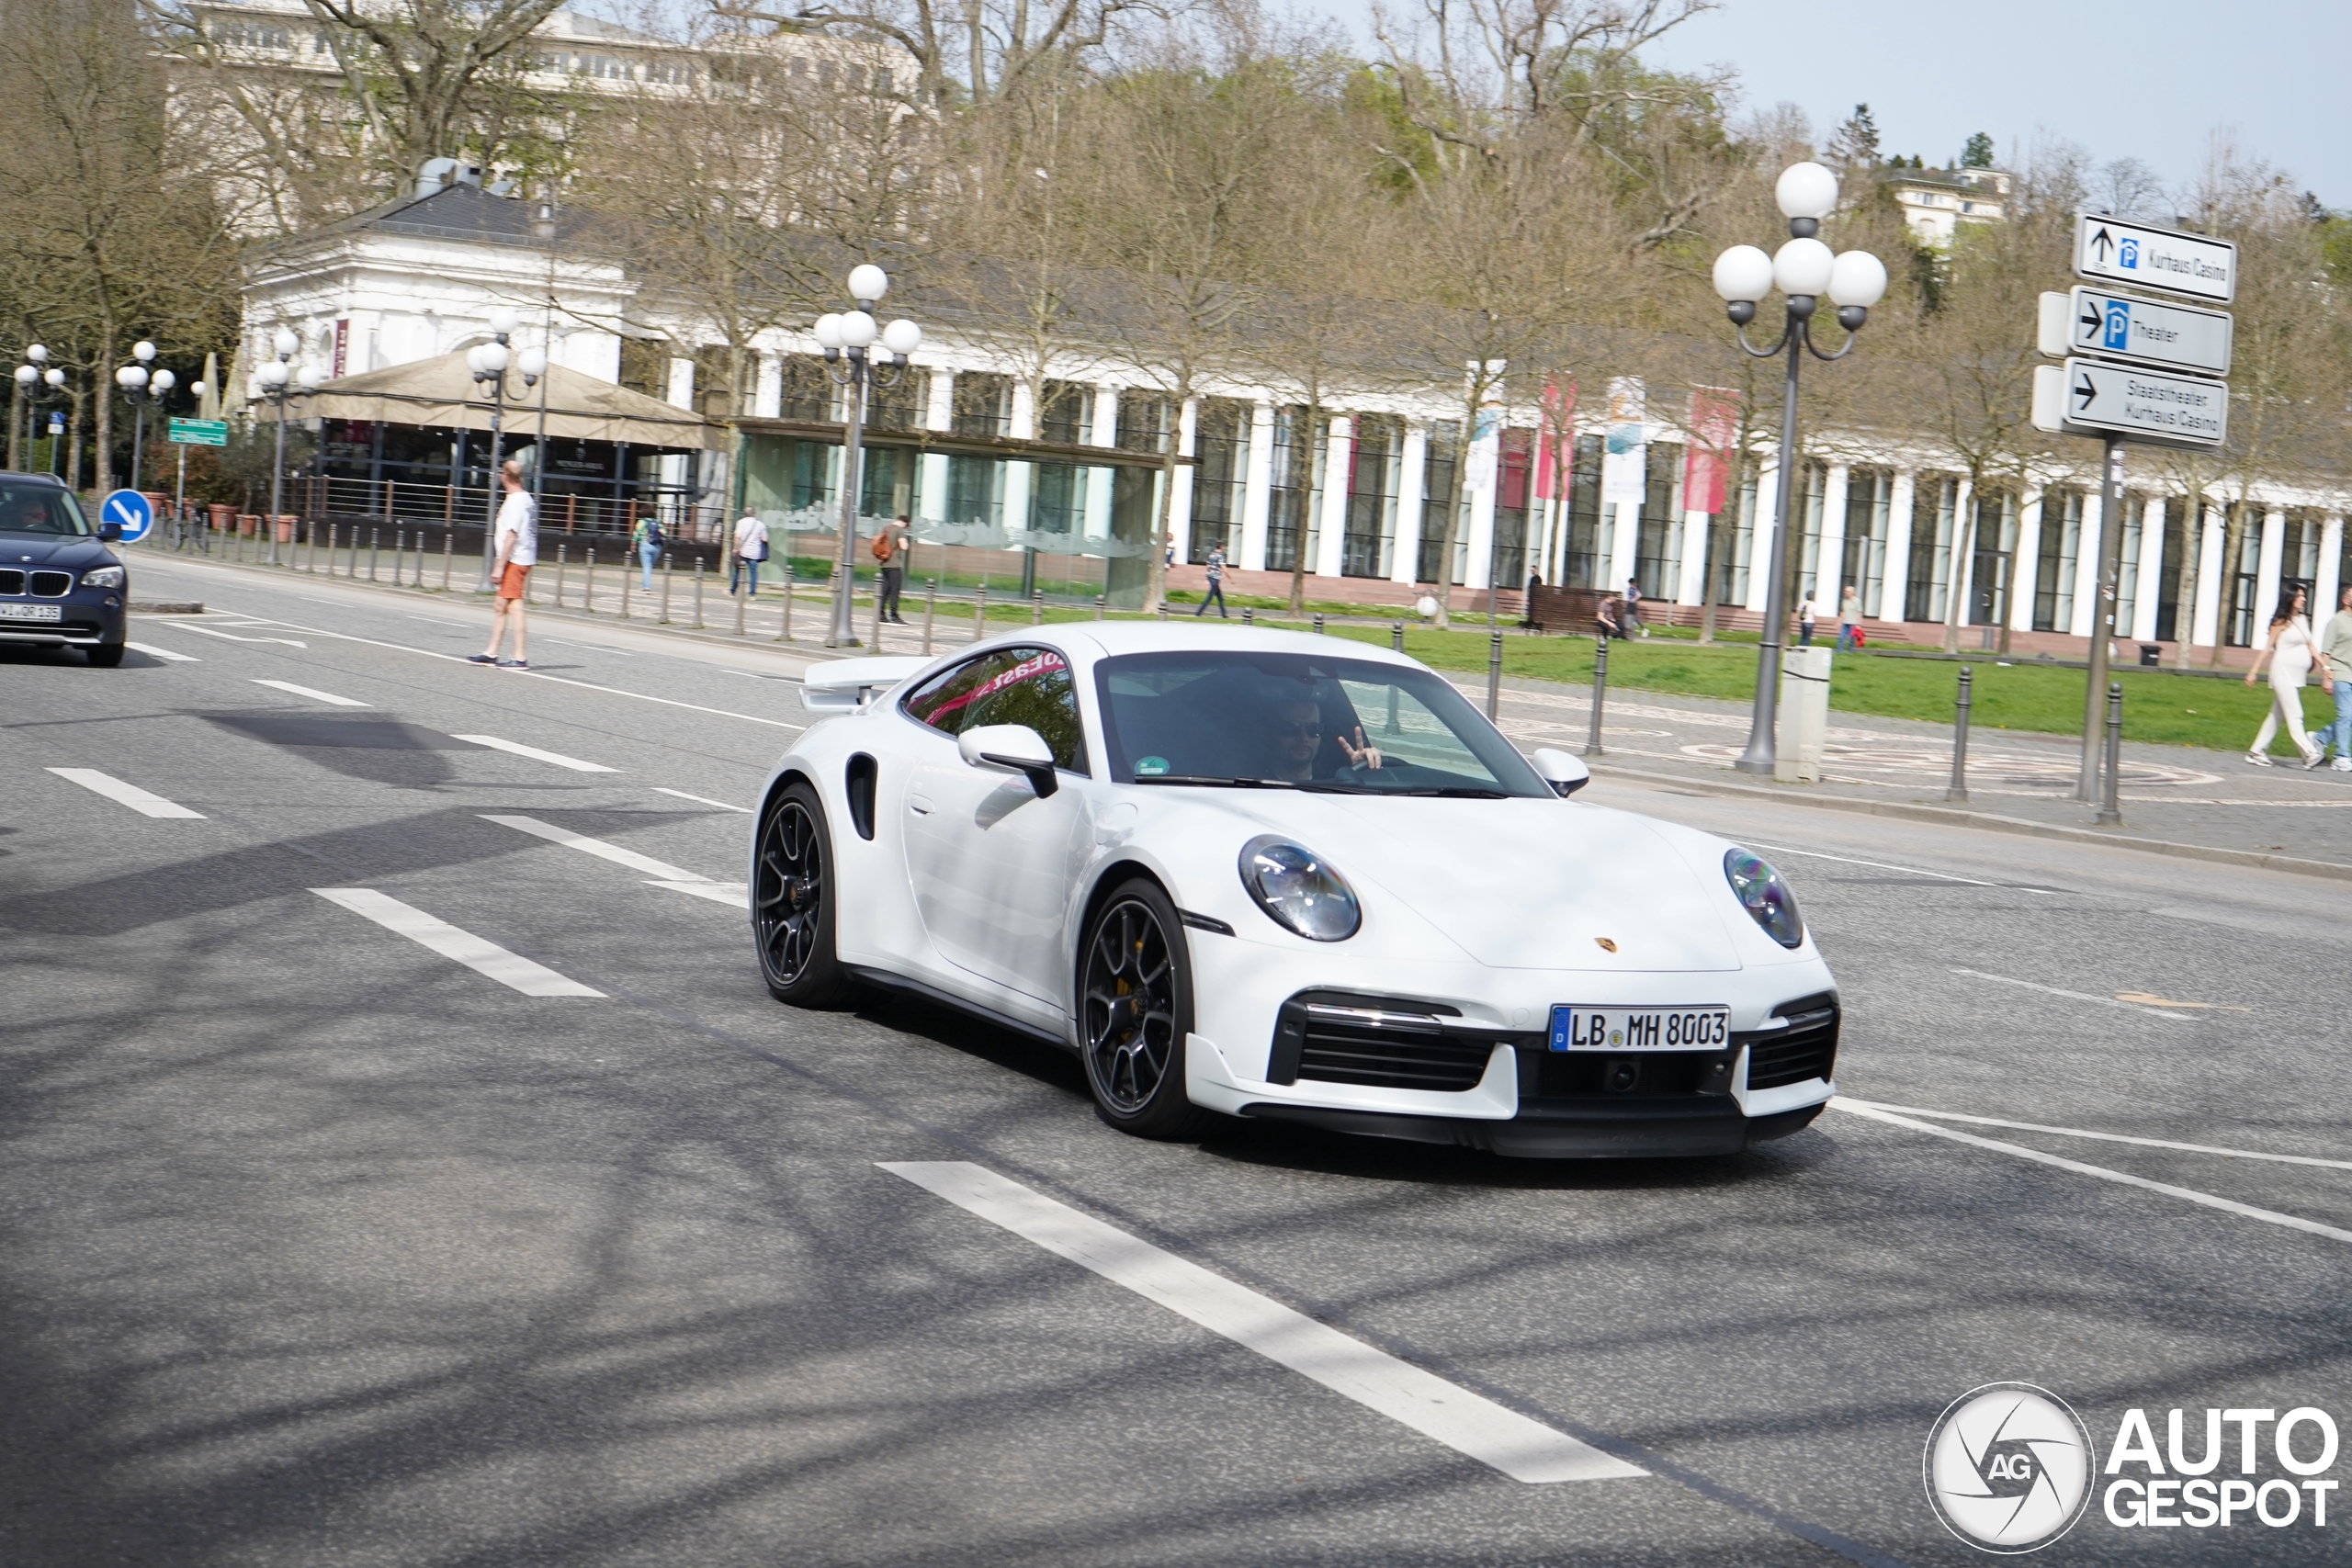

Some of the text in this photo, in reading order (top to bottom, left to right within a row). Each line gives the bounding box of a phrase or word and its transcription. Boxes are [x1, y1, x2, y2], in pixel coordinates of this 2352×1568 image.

[2148, 248, 2191, 275] Kurhaus
[2192, 256, 2227, 282] Casino
[2132, 320, 2179, 344] Theater
[2126, 378, 2209, 407] Staatstheater
[2124, 401, 2218, 432] Kurhaus Casino
[1571, 1014, 1606, 1046] LB
[1627, 1014, 1661, 1046] MH
[1667, 1012, 1726, 1045] 8003
